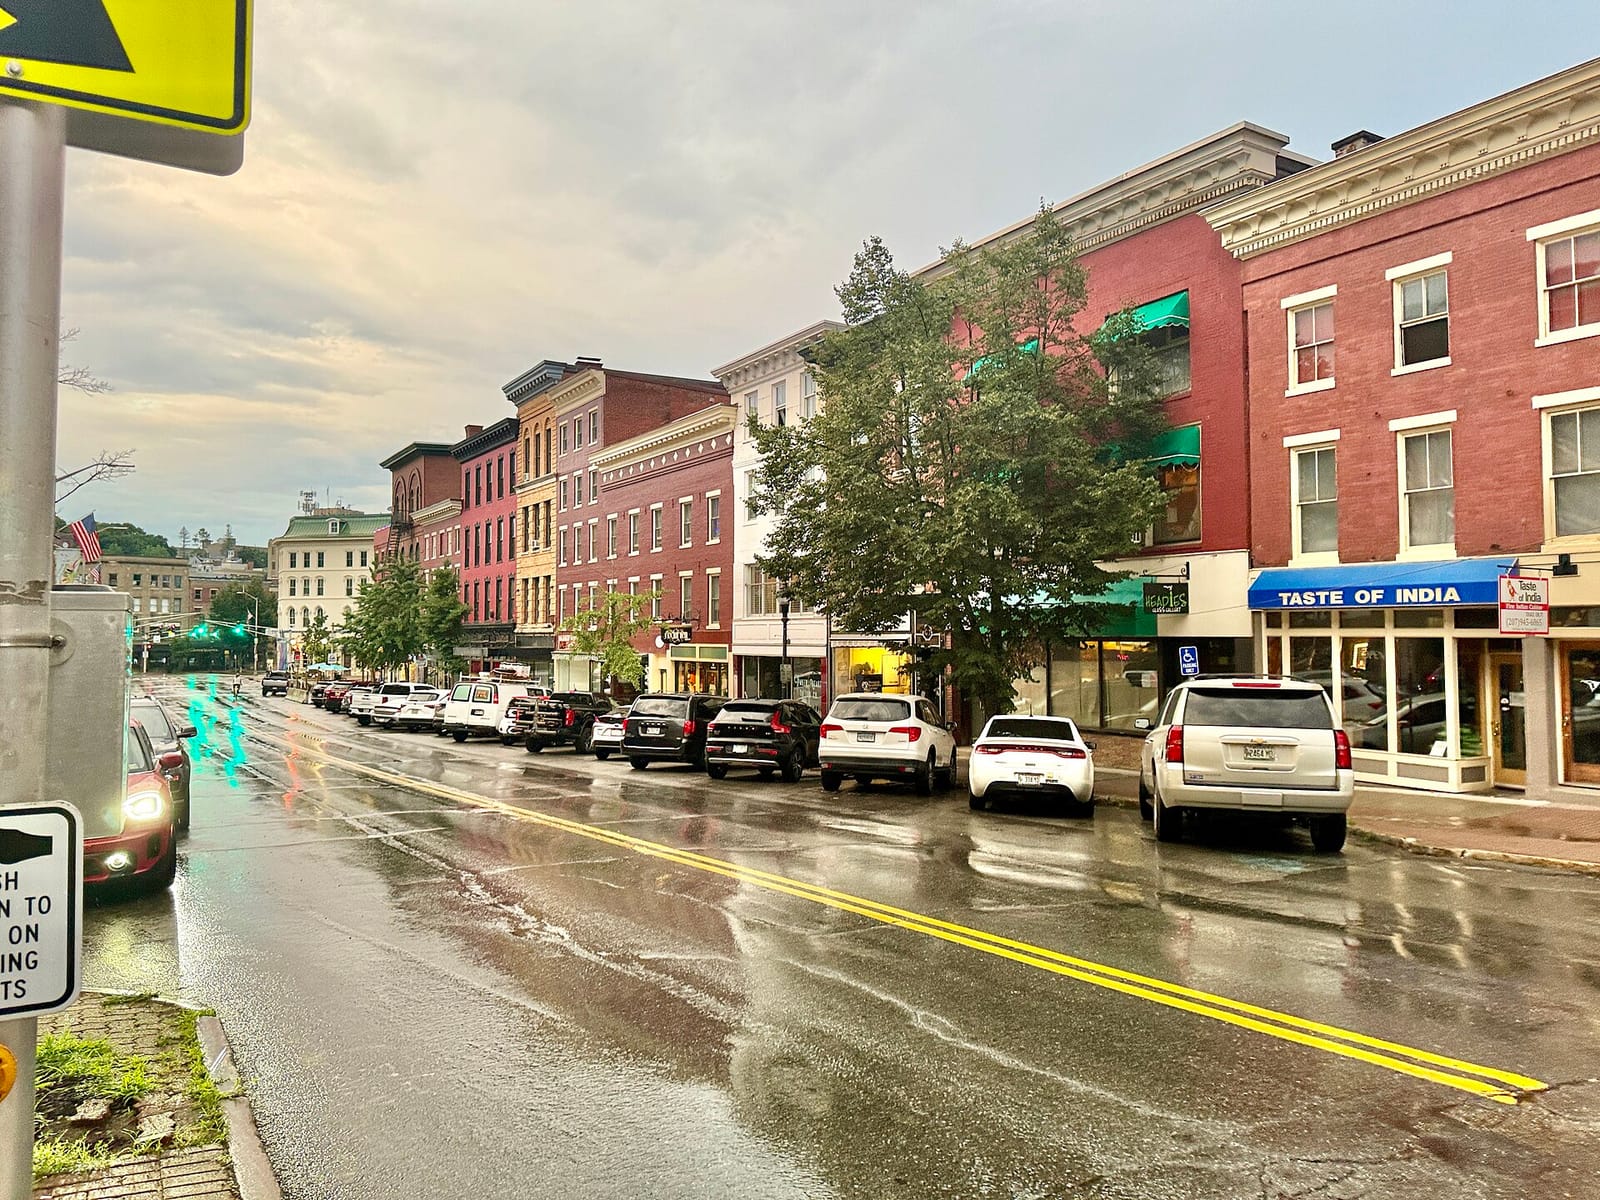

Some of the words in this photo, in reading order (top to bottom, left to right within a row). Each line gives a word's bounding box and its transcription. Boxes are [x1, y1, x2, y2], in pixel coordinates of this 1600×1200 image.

[1518, 580, 1537, 591] Taste
[1145, 591, 1187, 607] HEADIES
[1279, 591, 1344, 606] TASTE
[1354, 589, 1385, 604] OF
[1395, 587, 1461, 604] INDIA
[1525, 592, 1542, 603] India
[24, 895, 52, 916] TO
[8, 923, 39, 945] ON
[0, 979, 27, 1001] TS
